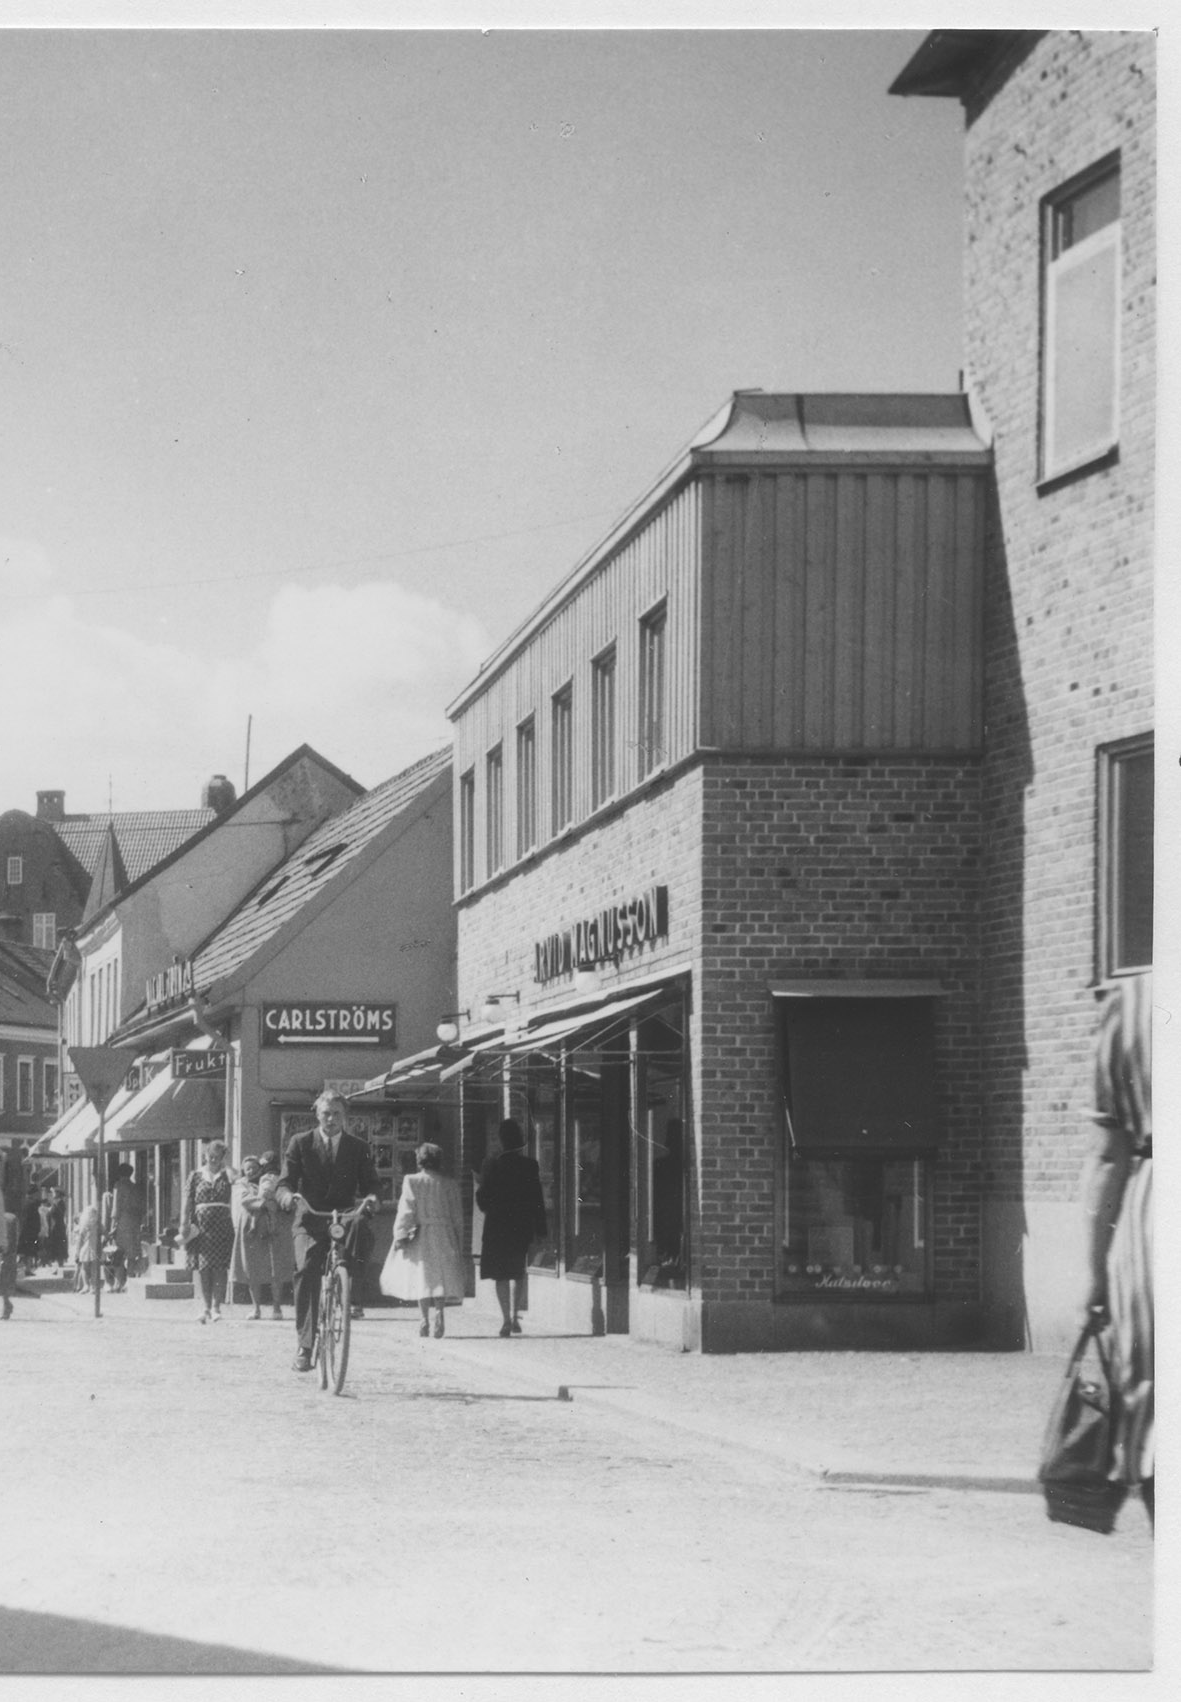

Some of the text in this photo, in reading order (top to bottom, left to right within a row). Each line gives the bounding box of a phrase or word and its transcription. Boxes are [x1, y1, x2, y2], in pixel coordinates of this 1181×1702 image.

[570, 886, 659, 968] MAGNUSSON
[265, 1005, 393, 1031] CARLSTRÖMS
[175, 1052, 226, 1076] Frukt
